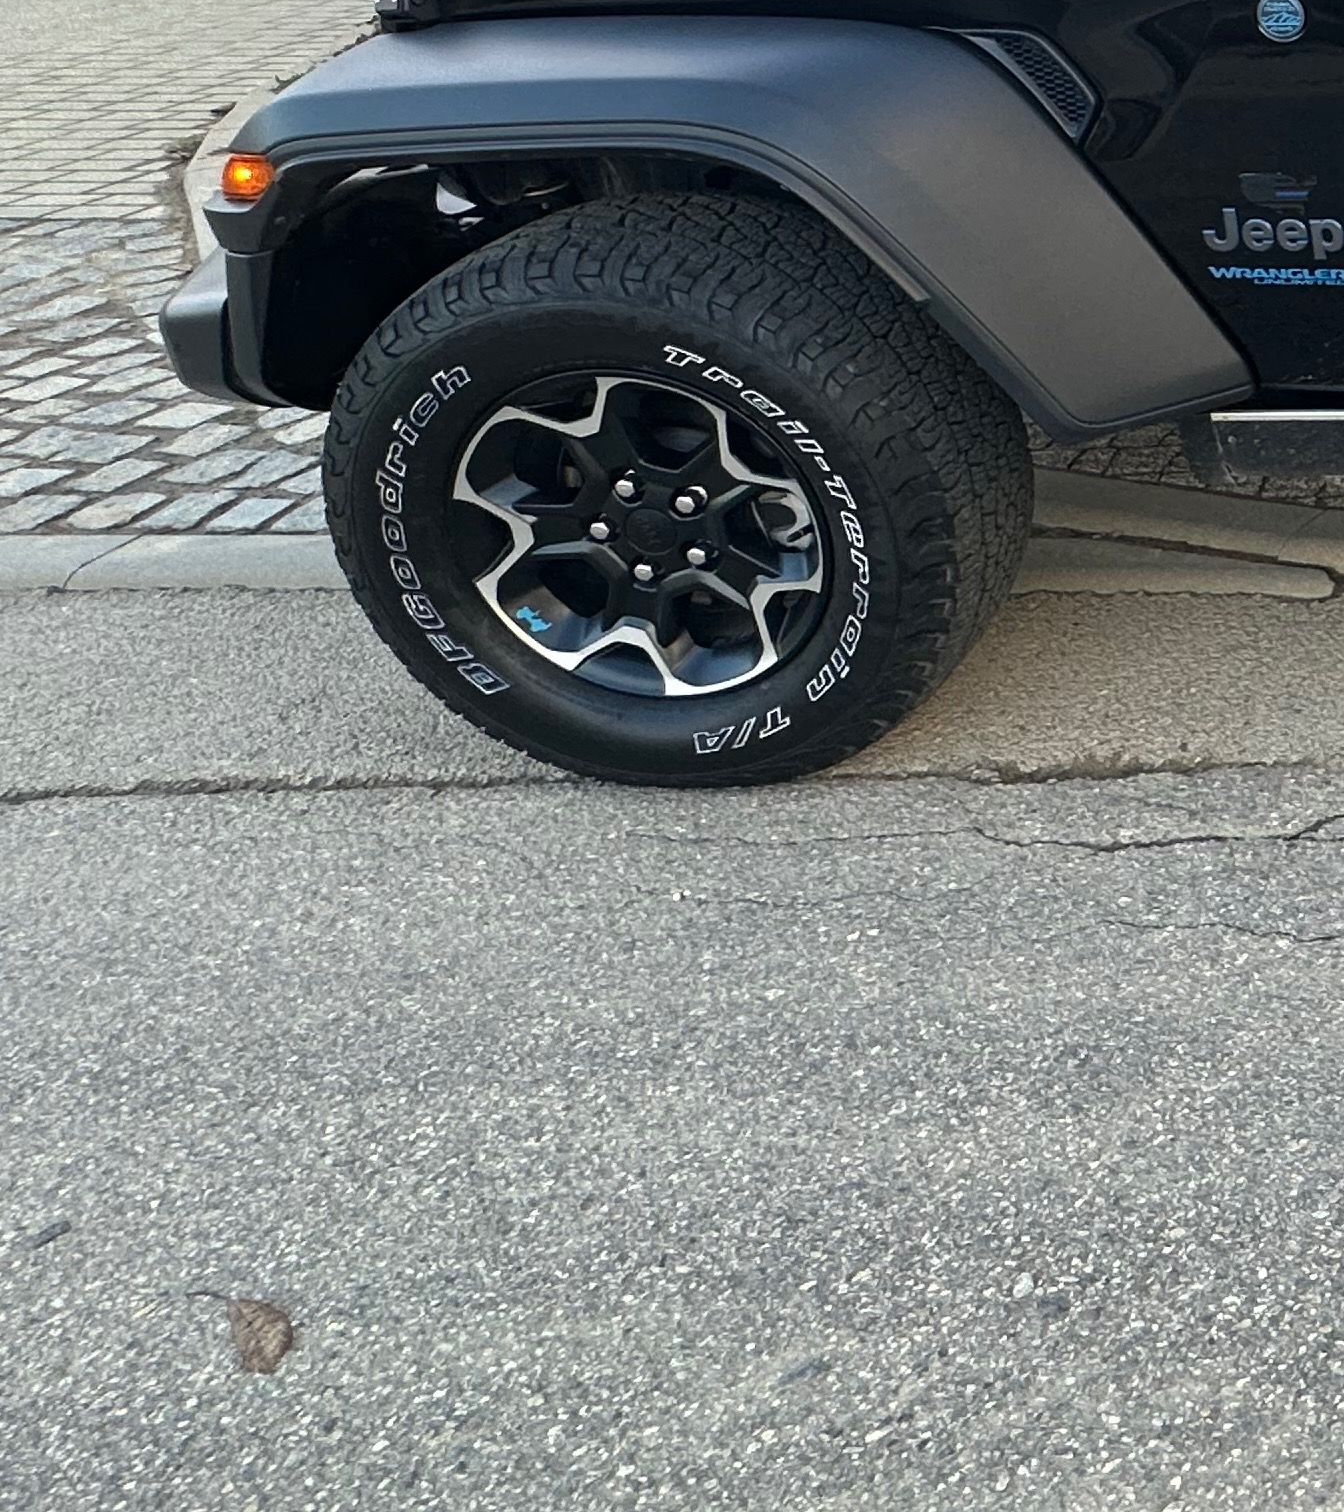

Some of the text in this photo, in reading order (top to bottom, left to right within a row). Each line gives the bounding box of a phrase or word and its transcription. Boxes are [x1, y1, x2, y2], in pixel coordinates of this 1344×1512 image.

[1202, 207, 1344, 260] Jeep
[376, 364, 510, 695] BFGoodrich
[663, 344, 870, 754] Trail-Terrain T/A
